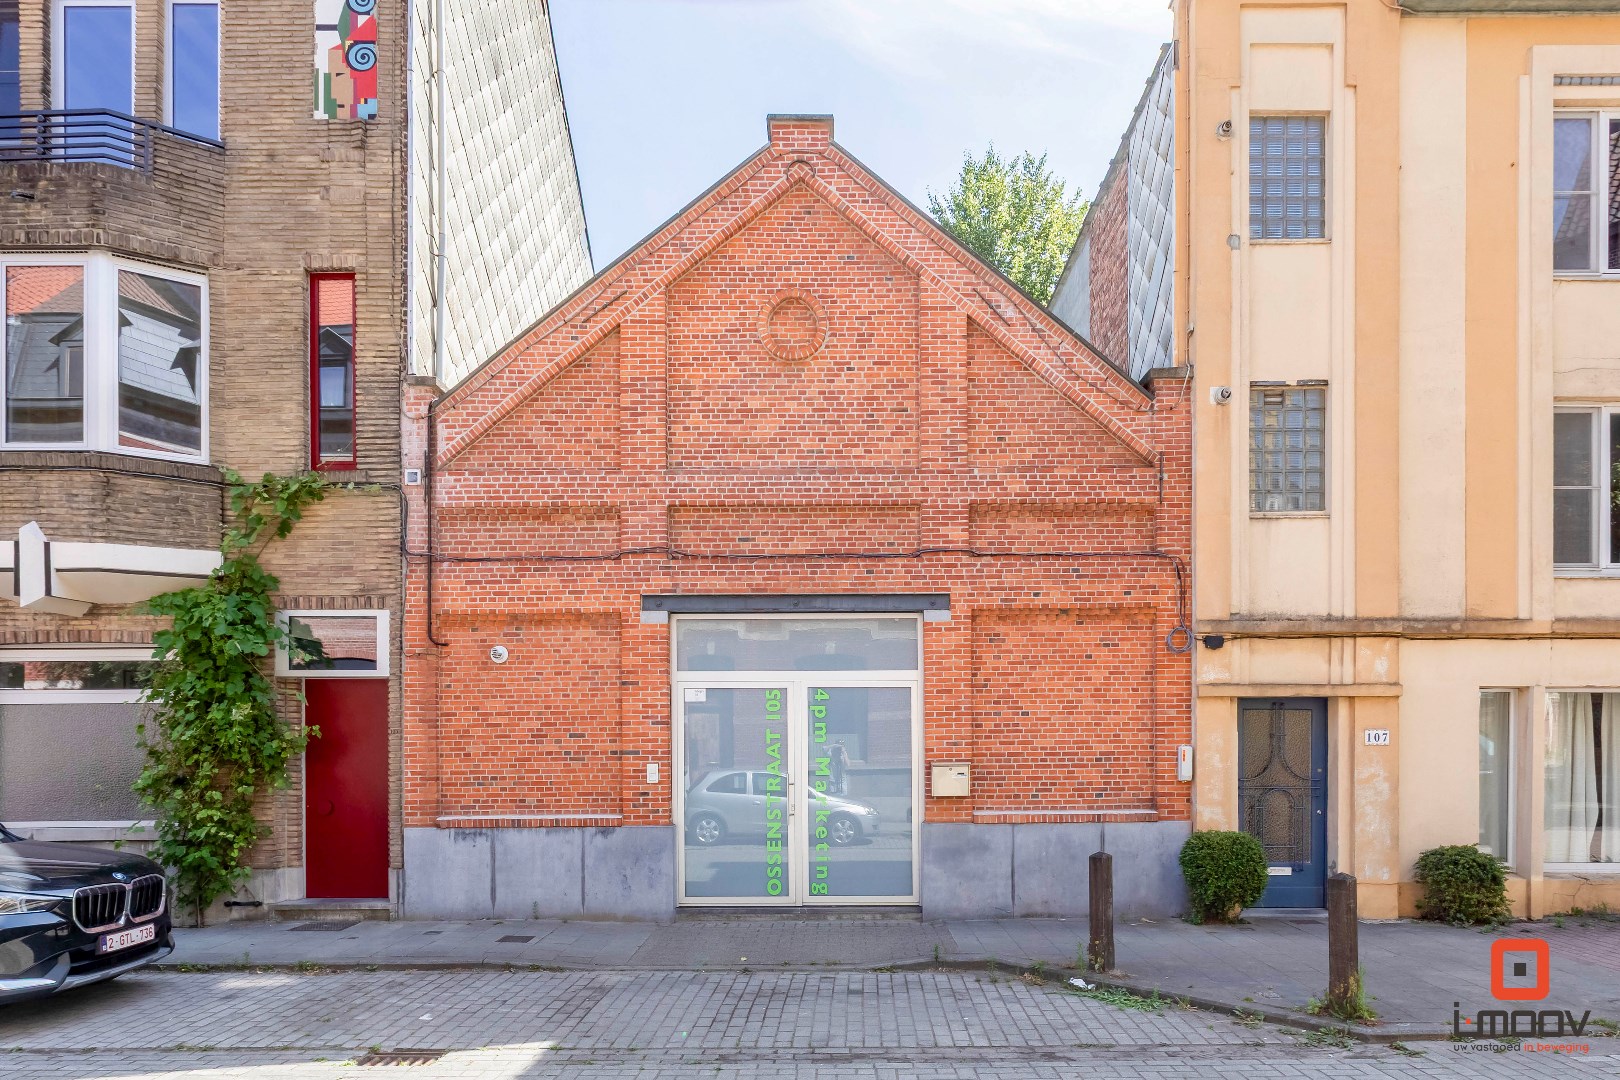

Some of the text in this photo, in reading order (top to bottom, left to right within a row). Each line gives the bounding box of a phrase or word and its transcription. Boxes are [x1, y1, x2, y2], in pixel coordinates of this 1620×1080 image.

[765, 689, 782, 896] OSSENSTRAAT 105
[809, 688, 831, 895] 4pm Marketing
[1366, 732, 1388, 743] 107
